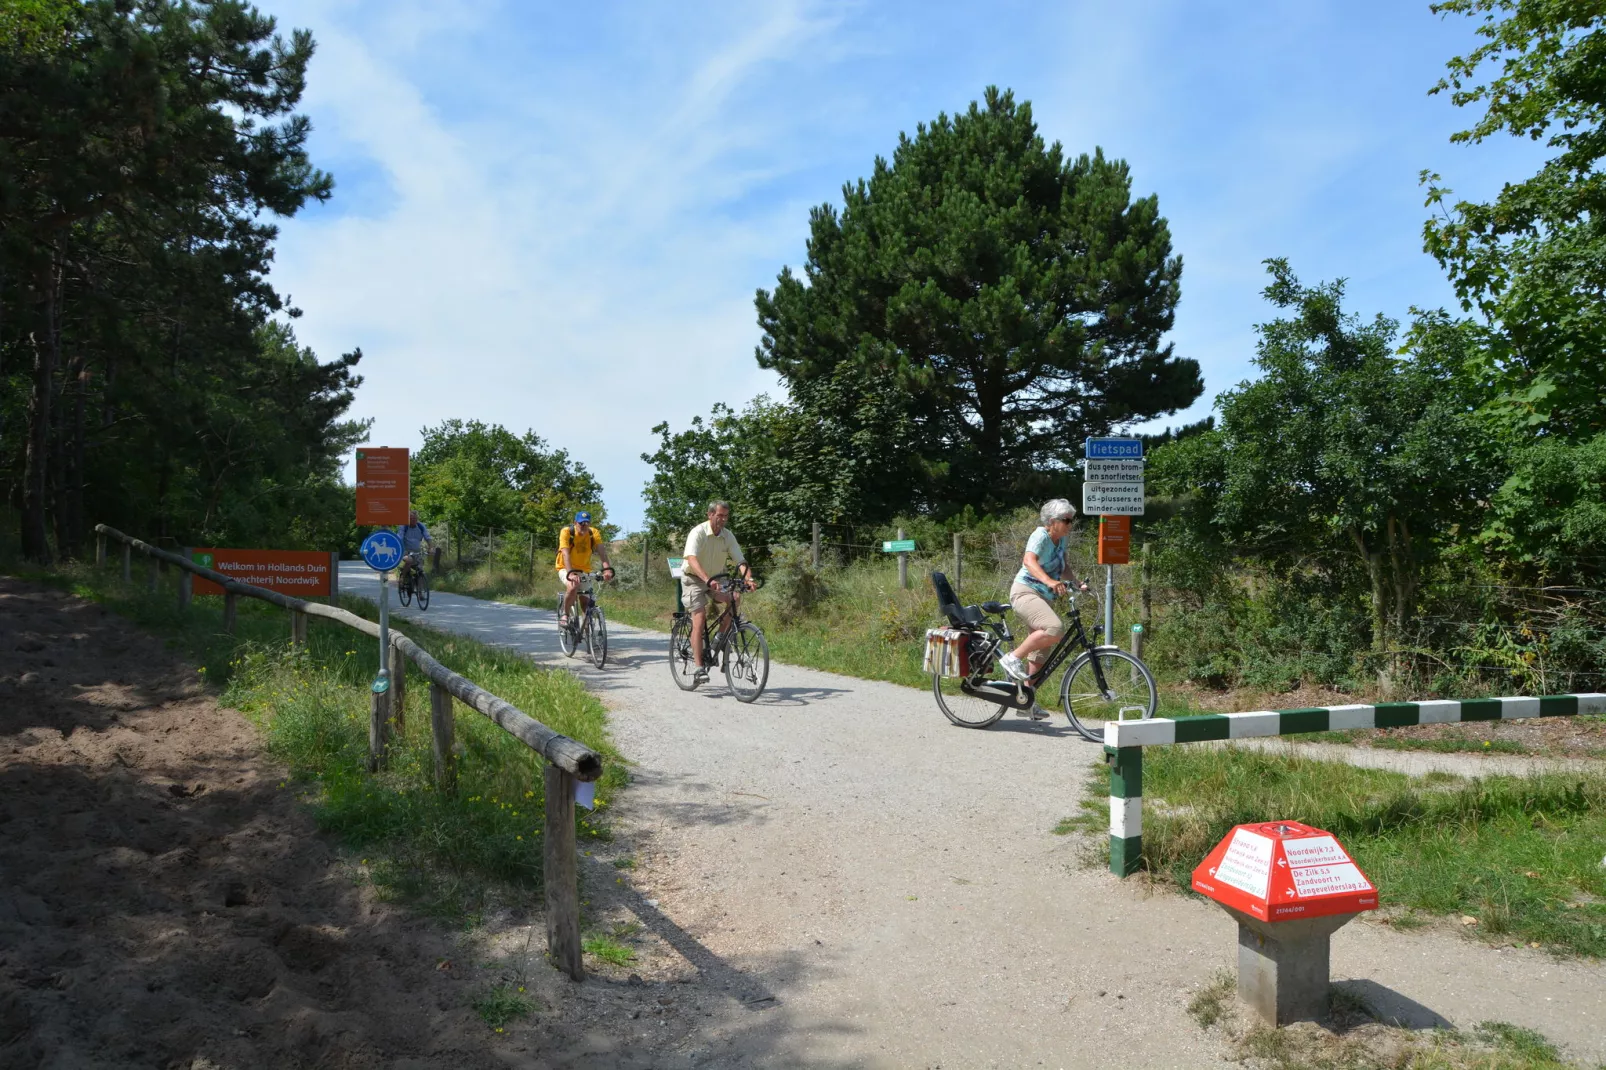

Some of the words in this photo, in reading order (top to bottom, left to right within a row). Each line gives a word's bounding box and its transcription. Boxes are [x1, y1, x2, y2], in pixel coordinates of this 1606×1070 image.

[1092, 444, 1139, 455] fietspad
[1103, 464, 1120, 472] geen
[1121, 463, 1142, 471] brom-
[1087, 495, 1132, 503] 65-plussers
[218, 562, 255, 571] Welkom
[257, 562, 265, 571] in
[268, 563, 305, 572] Hollands
[307, 564, 327, 573] Duin
[276, 576, 320, 586] Noordwijk
[1287, 847, 1324, 857] Noordwijk
[1289, 856, 1337, 865] Noordwijkerhout
[1293, 870, 1303, 878] De
[1305, 868, 1319, 876] Zilk
[1296, 877, 1333, 886] Zandvoort
[1298, 883, 1357, 896] Langevelderslag
